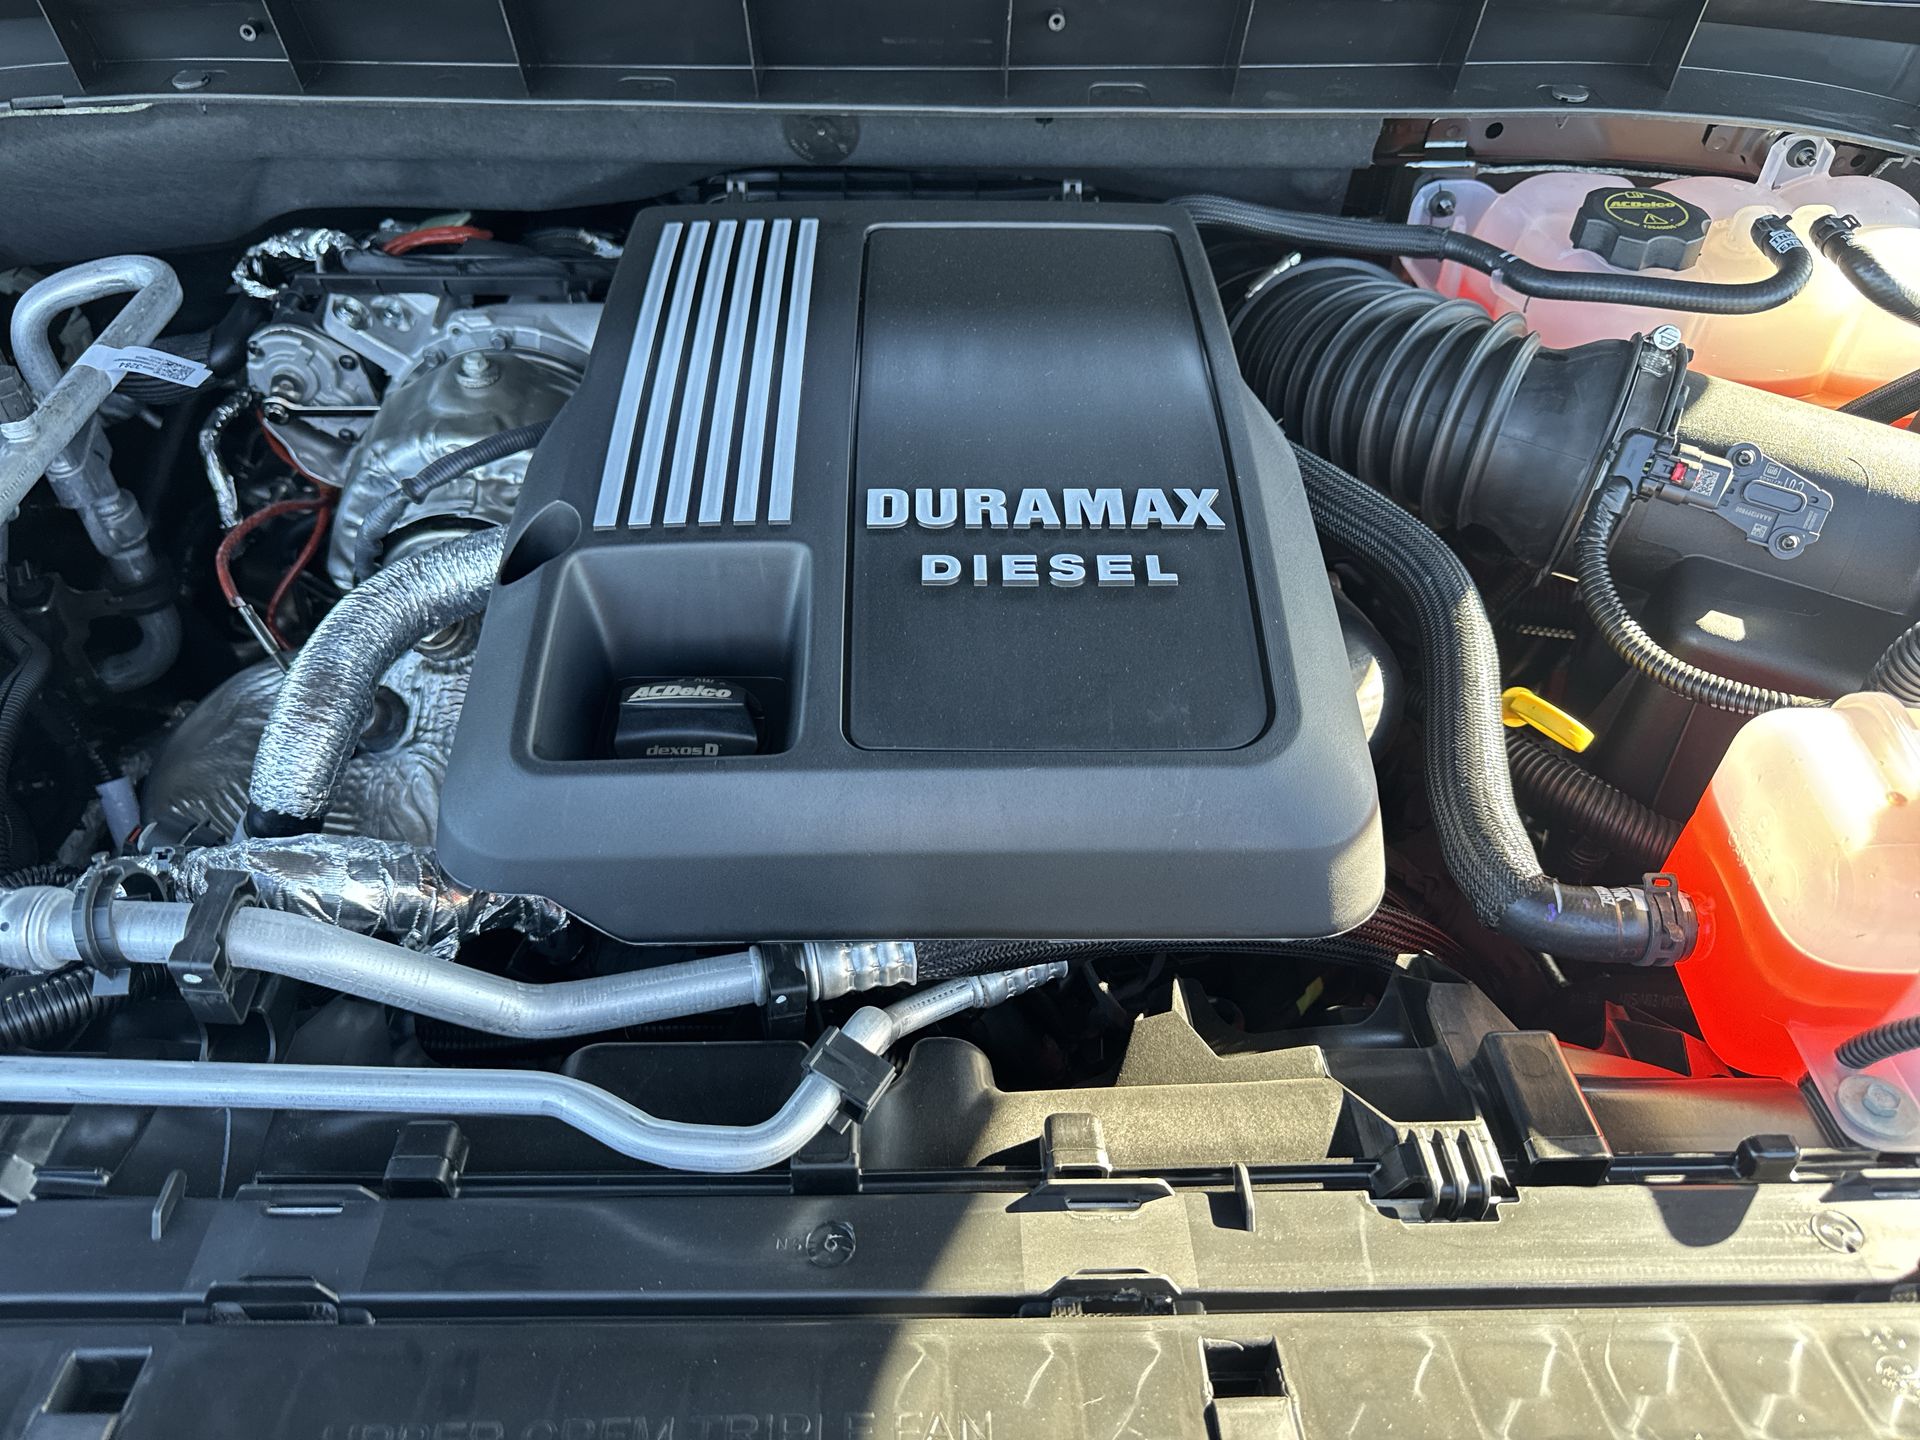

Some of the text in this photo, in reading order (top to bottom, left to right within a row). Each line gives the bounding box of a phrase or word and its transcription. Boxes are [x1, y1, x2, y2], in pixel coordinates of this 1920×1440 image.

[1609, 201, 1676, 210] ACDelco
[866, 488, 1225, 529] DURAMAX
[921, 554, 1178, 586] DIESEL
[627, 685, 732, 702] ACDelco
